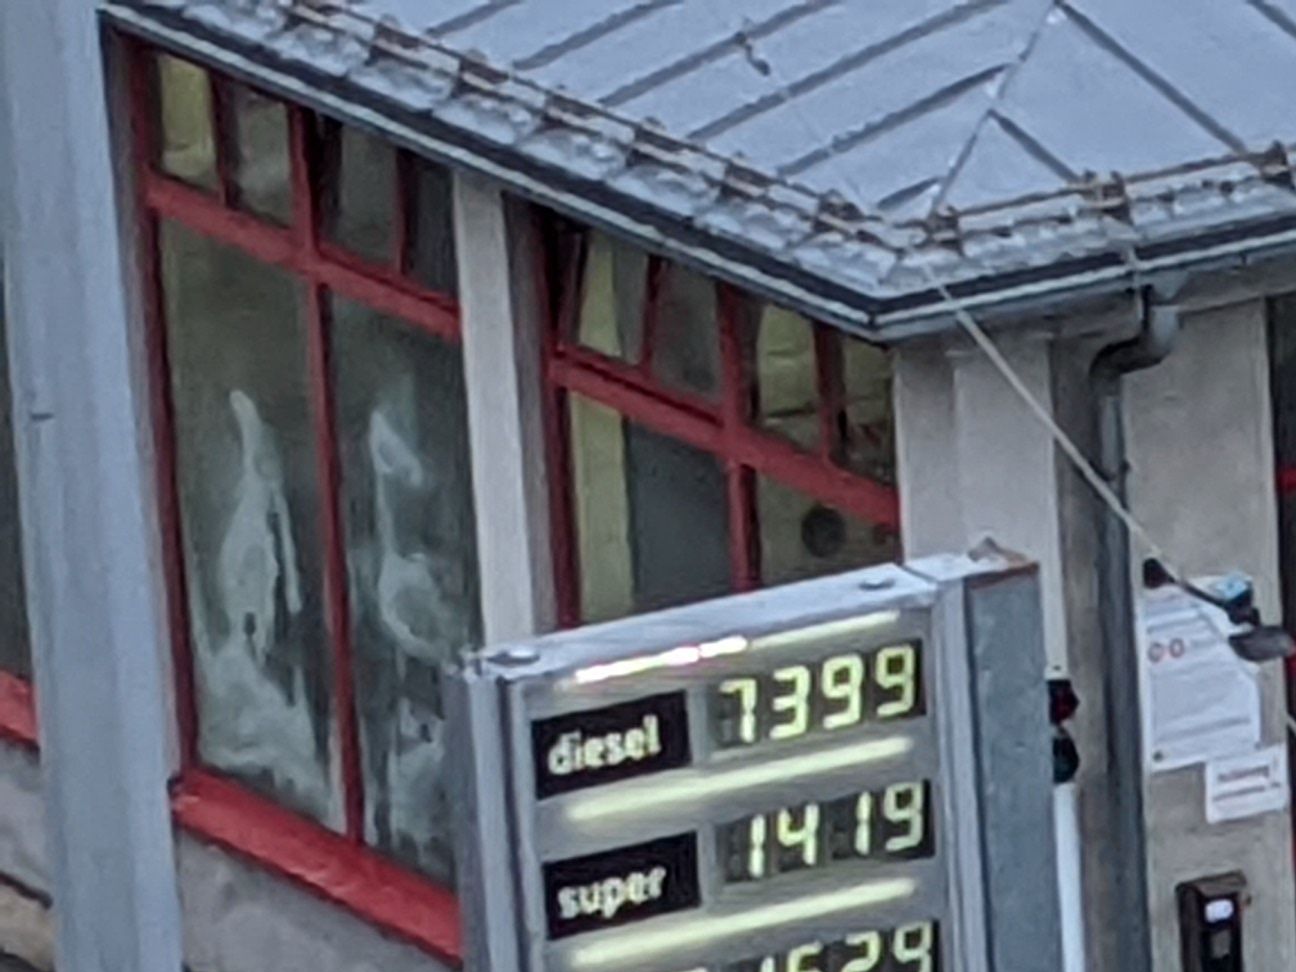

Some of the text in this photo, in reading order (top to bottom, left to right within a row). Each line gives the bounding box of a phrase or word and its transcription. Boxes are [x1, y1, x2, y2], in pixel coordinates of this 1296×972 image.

[548, 714, 662, 776] diesel
[556, 780, 925, 920] super 1419
